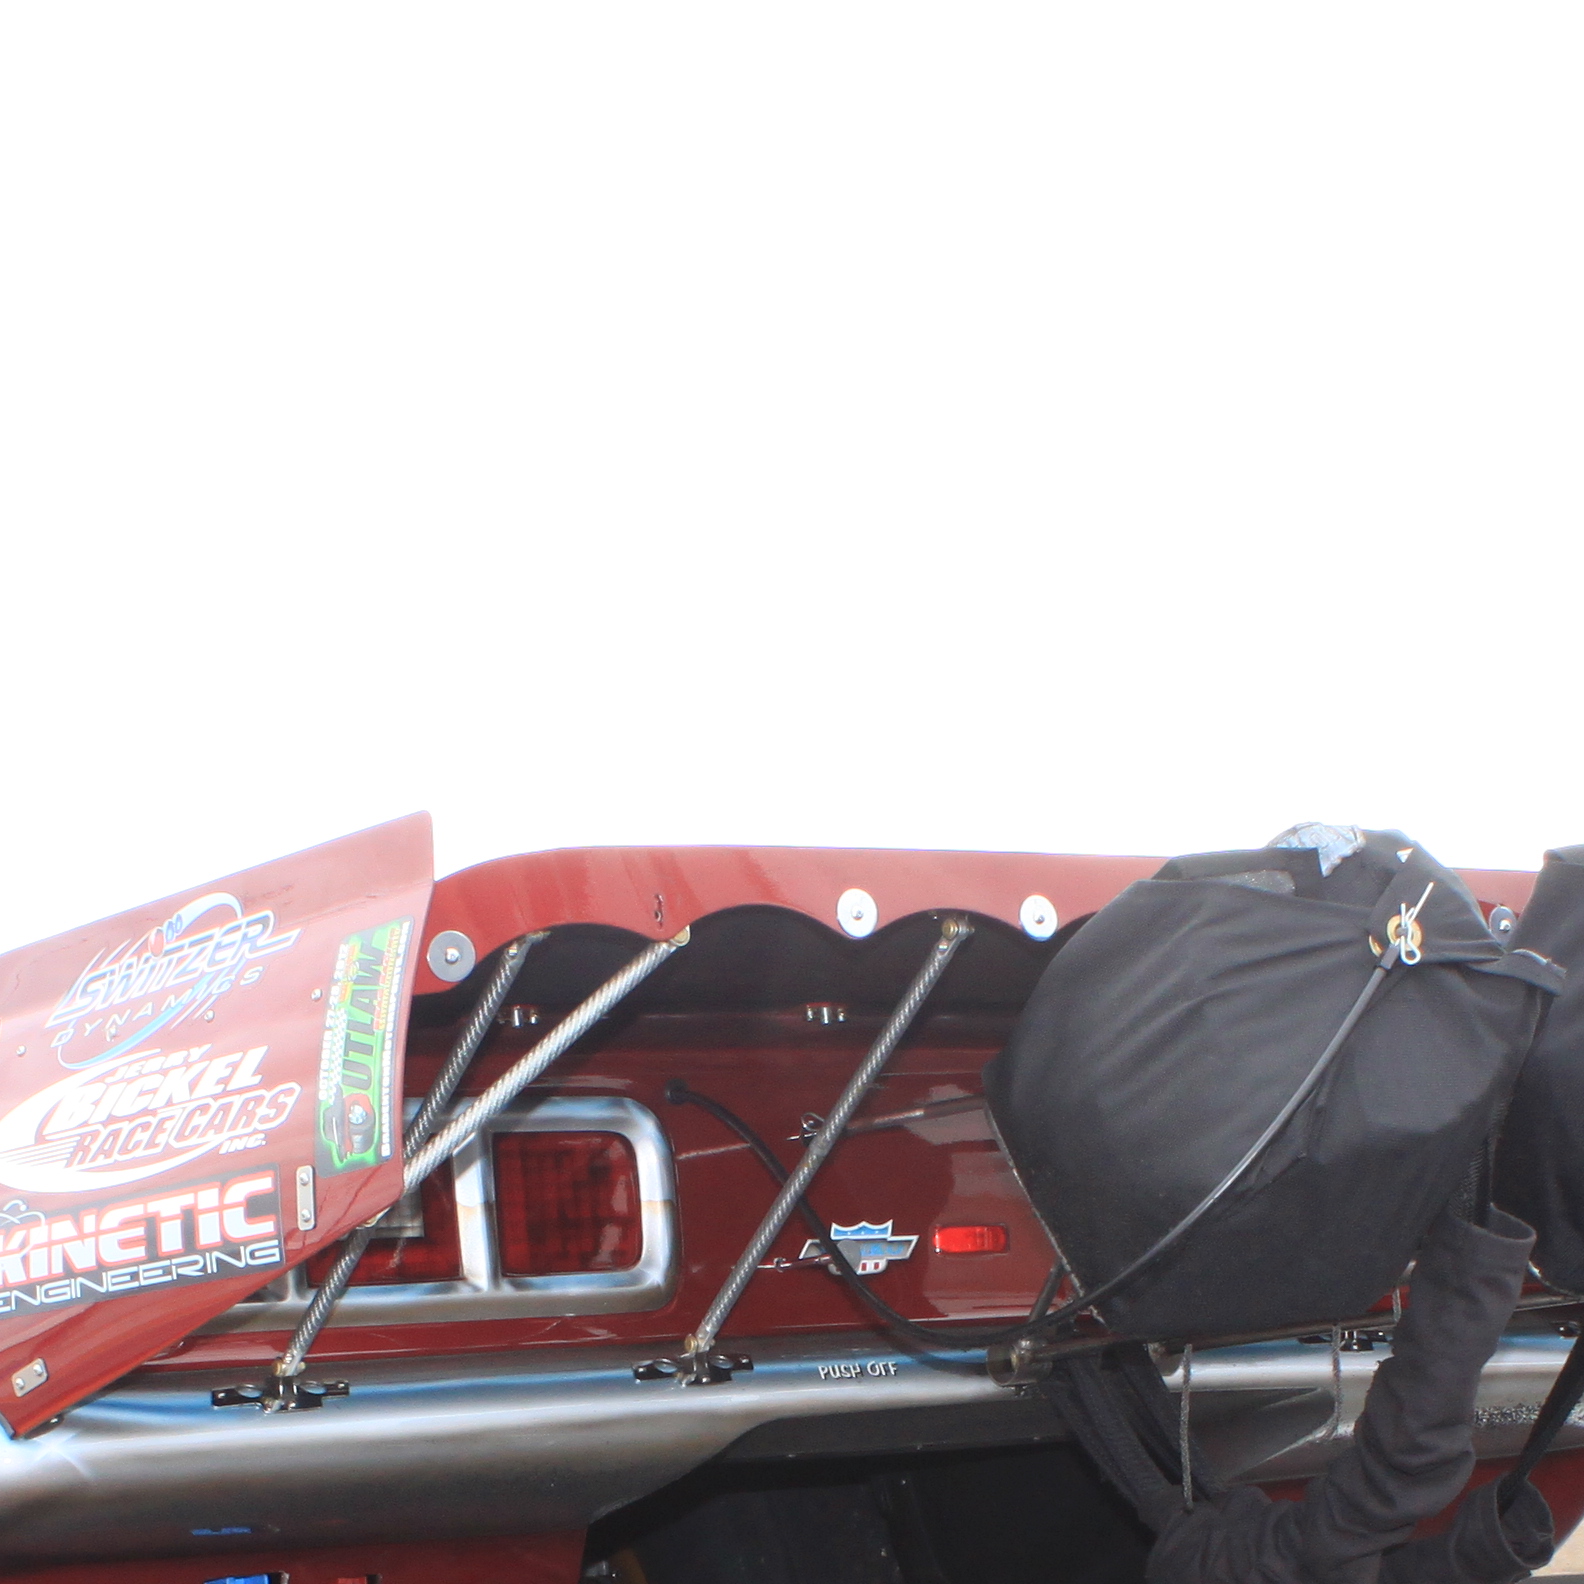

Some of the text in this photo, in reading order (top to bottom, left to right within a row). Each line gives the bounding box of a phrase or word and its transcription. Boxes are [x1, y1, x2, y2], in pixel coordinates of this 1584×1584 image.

[50, 966, 265, 1047] DYNAMICS
[107, 1043, 213, 1084] JERRY
[219, 1133, 268, 1155] INC.
[818, 1361, 899, 1380] PUSH OFF
